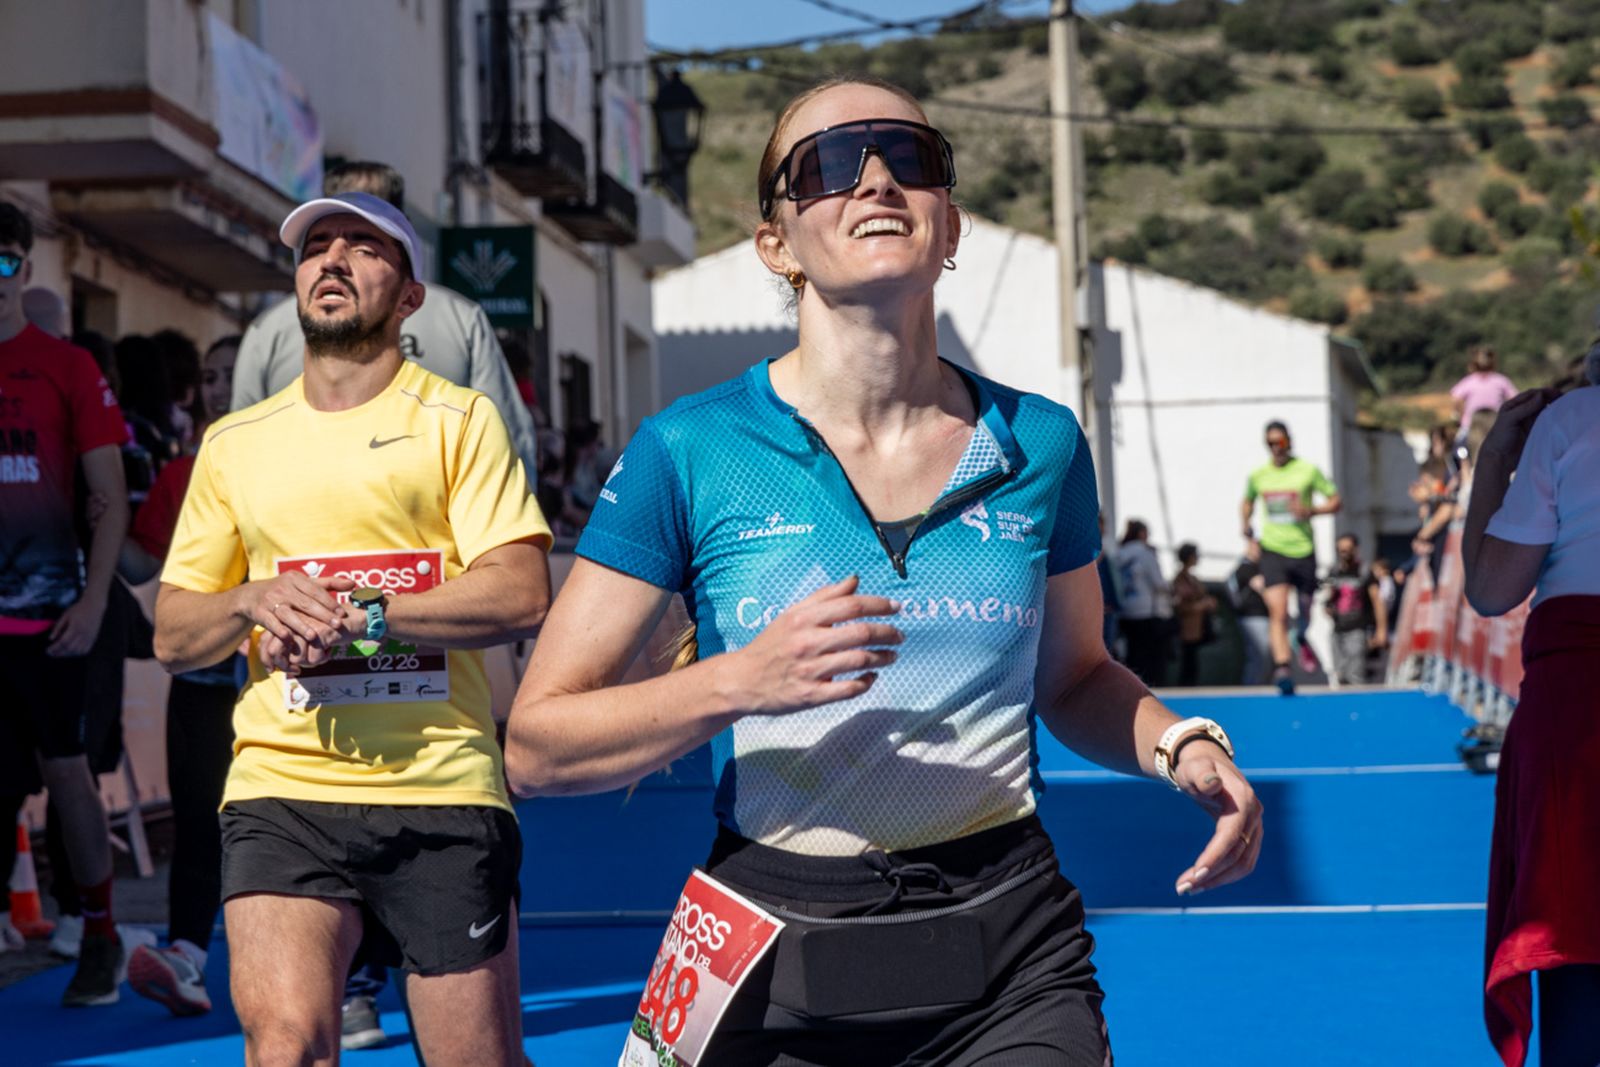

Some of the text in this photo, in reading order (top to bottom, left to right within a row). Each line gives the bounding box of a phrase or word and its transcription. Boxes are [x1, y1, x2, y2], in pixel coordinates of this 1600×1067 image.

[996, 510, 1035, 526] SIERRA
[737, 524, 816, 541] TEAMERGY
[395, 653, 420, 670] 26
